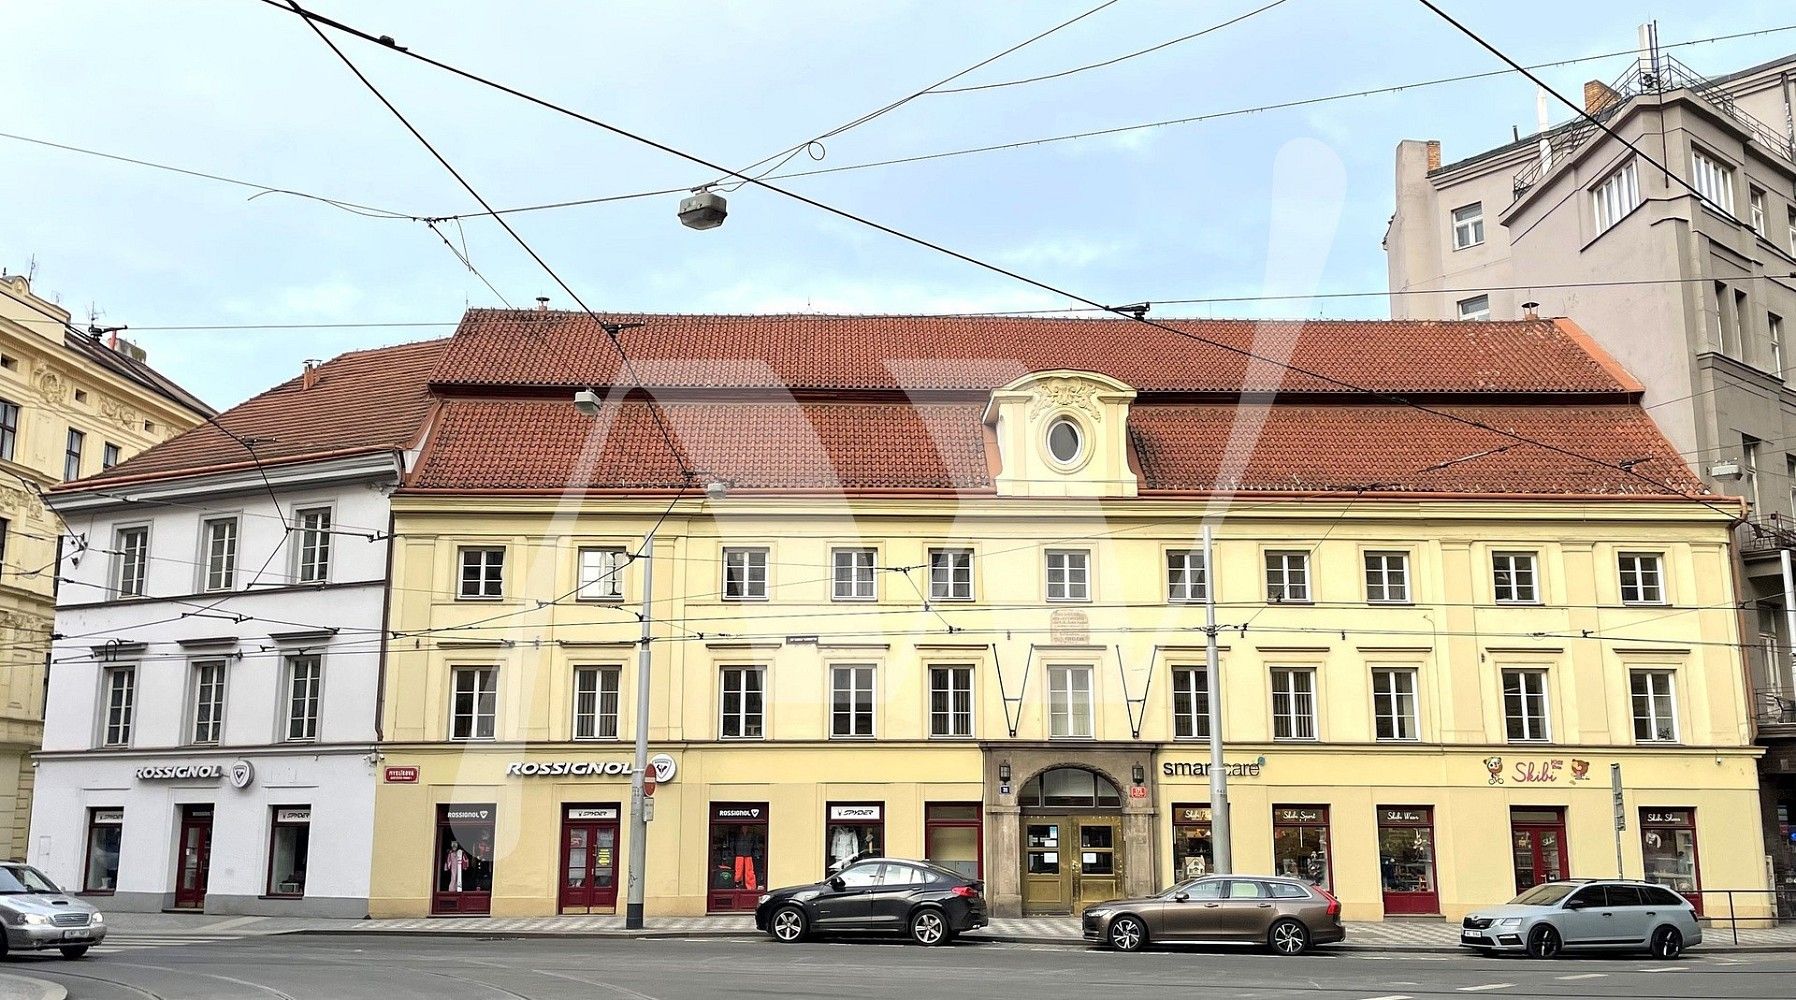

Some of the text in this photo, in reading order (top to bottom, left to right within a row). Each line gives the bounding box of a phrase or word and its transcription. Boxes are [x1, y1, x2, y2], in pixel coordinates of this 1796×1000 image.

[136, 765, 221, 779] ROSSIGNOL
[506, 761, 633, 776] ROSSIGNOL
[1163, 761, 1260, 776] smarcare
[1512, 761, 1557, 783] Skibi
